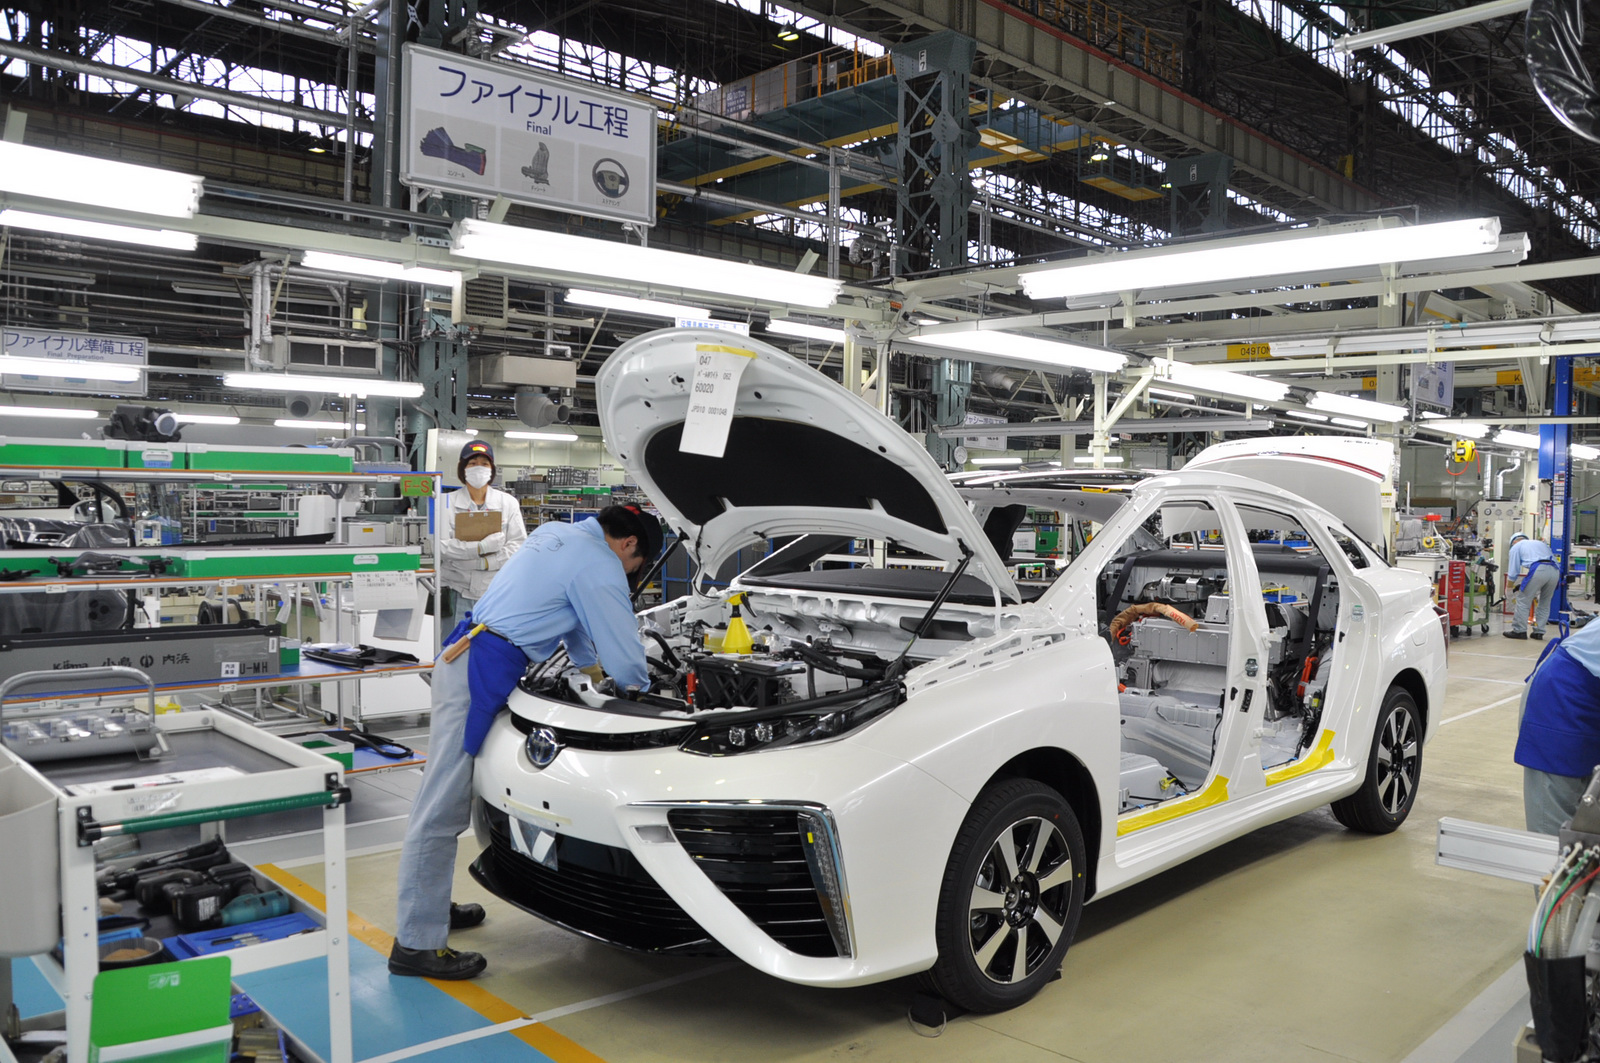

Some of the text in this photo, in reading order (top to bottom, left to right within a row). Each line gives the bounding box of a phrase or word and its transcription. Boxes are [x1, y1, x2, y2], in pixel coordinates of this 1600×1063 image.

[438, 65, 629, 139] ファイナル工程
[526, 120, 552, 136] Final
[4, 332, 144, 358] ファイナル準備工程
[67, 352, 104, 361] Preparation
[699, 355, 712, 366] 047
[695, 382, 714, 394] 60020
[404, 480, 430, 493] F-S
[162, 652, 191, 665] 内浜
[239, 662, 268, 675] U-MH
